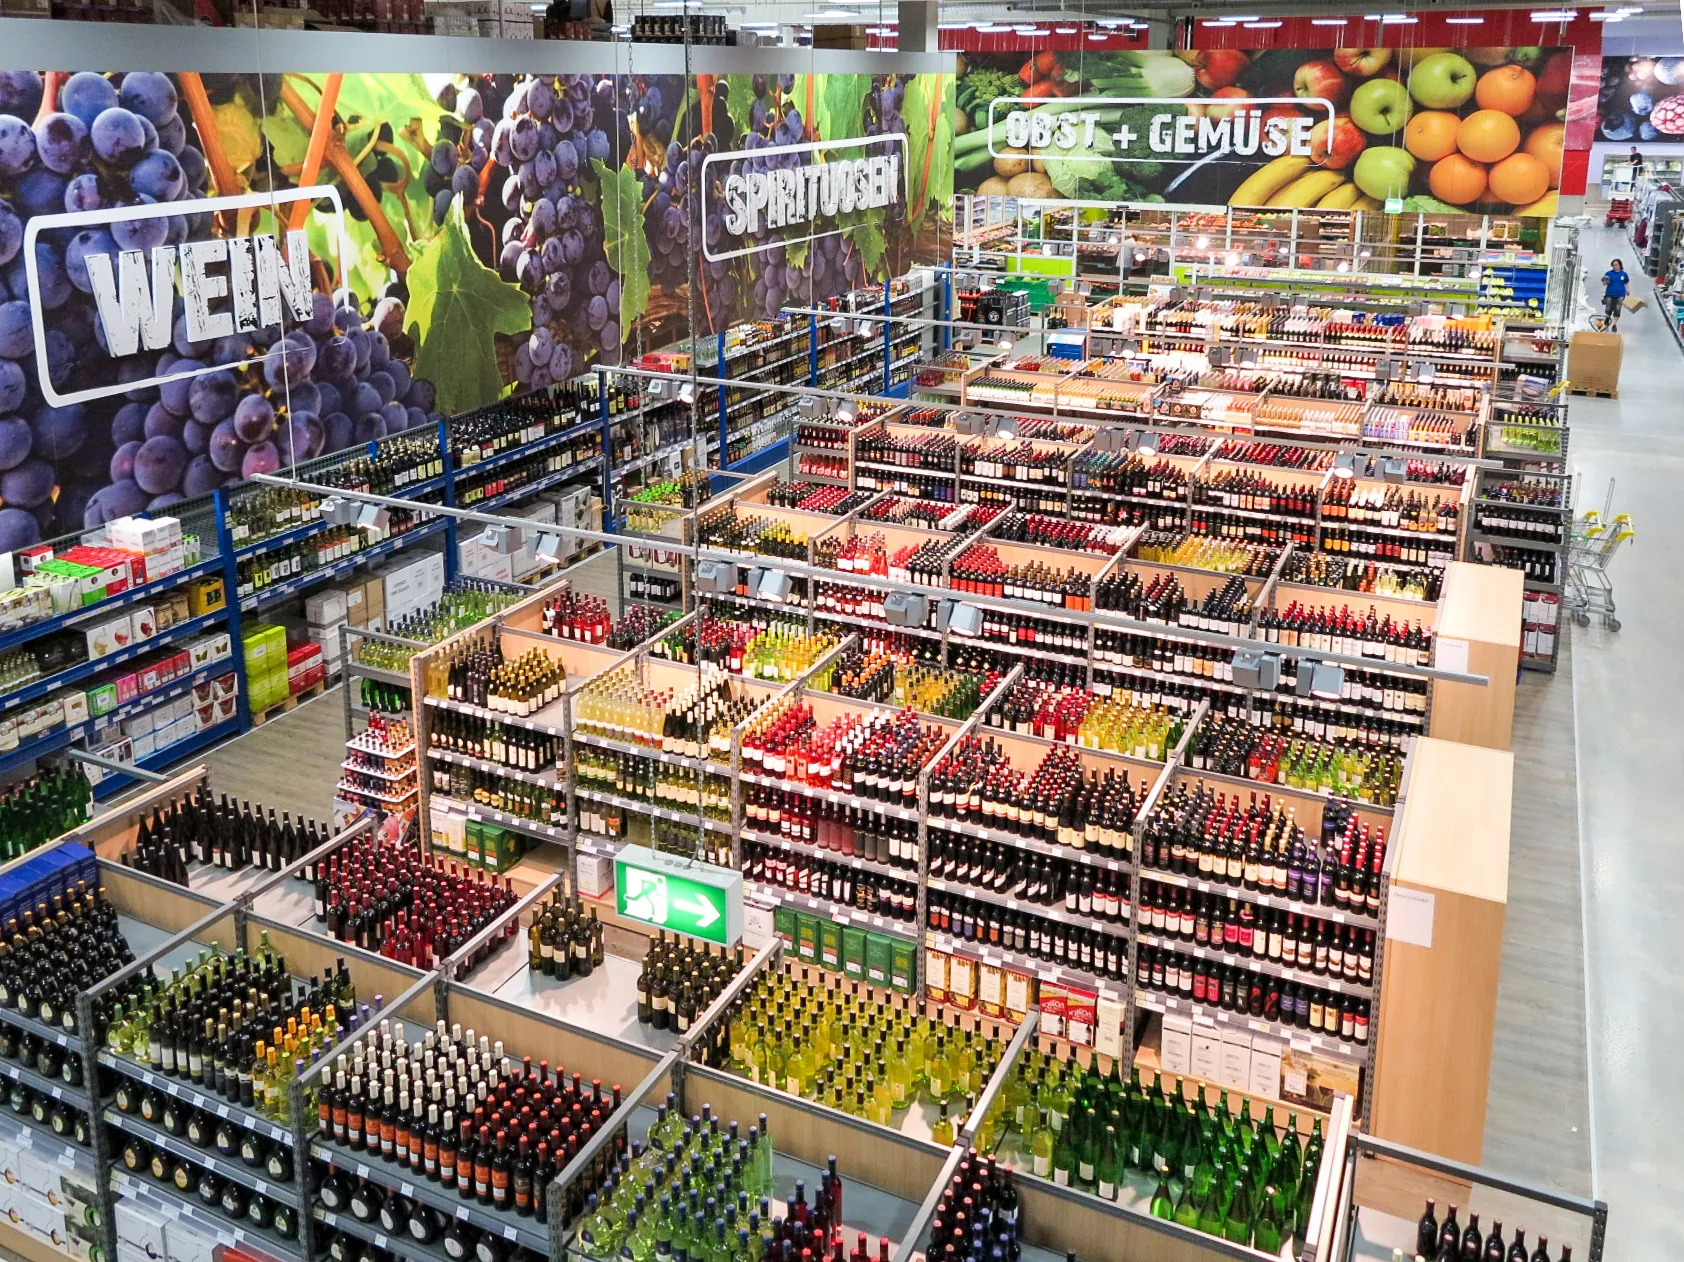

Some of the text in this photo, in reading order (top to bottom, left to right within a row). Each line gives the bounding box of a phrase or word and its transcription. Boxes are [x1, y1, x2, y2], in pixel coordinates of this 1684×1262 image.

[1006, 109, 1314, 157] OBST + GEMÜSE
[725, 154, 899, 236] SPIRITUOSEN
[84, 230, 313, 357] WEIN
